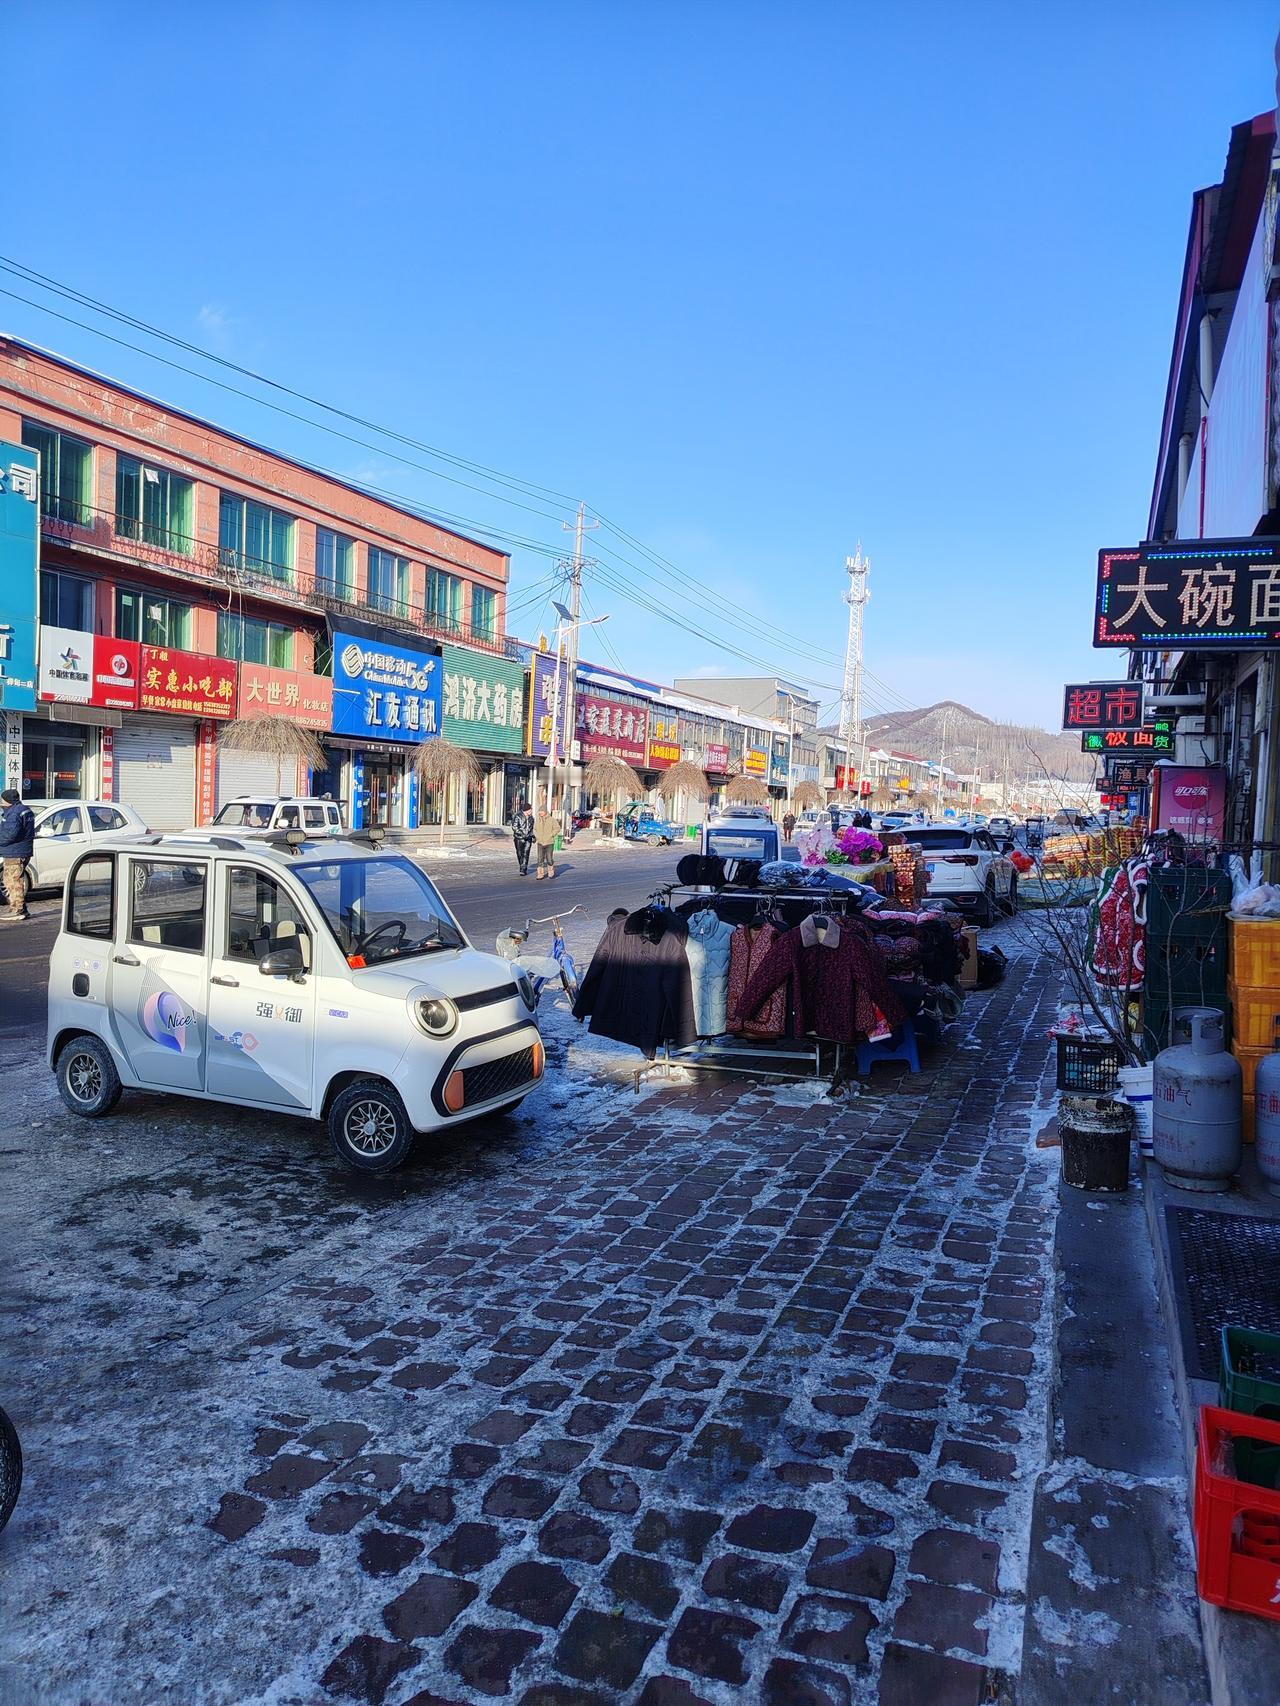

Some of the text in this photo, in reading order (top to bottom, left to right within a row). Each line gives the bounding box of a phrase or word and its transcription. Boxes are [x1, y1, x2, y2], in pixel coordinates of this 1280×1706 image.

[0, 463, 37, 501] 司
[1113, 562, 1280, 629] 大碗面
[364, 652, 406, 675] 中国移动
[145, 667, 233, 702] 实惠小吃部
[246, 677, 300, 707] 大世界
[365, 689, 438, 733] 汇友通讯
[1068, 688, 1139, 725] 超市
[167, 1010, 197, 1029] Nice!
